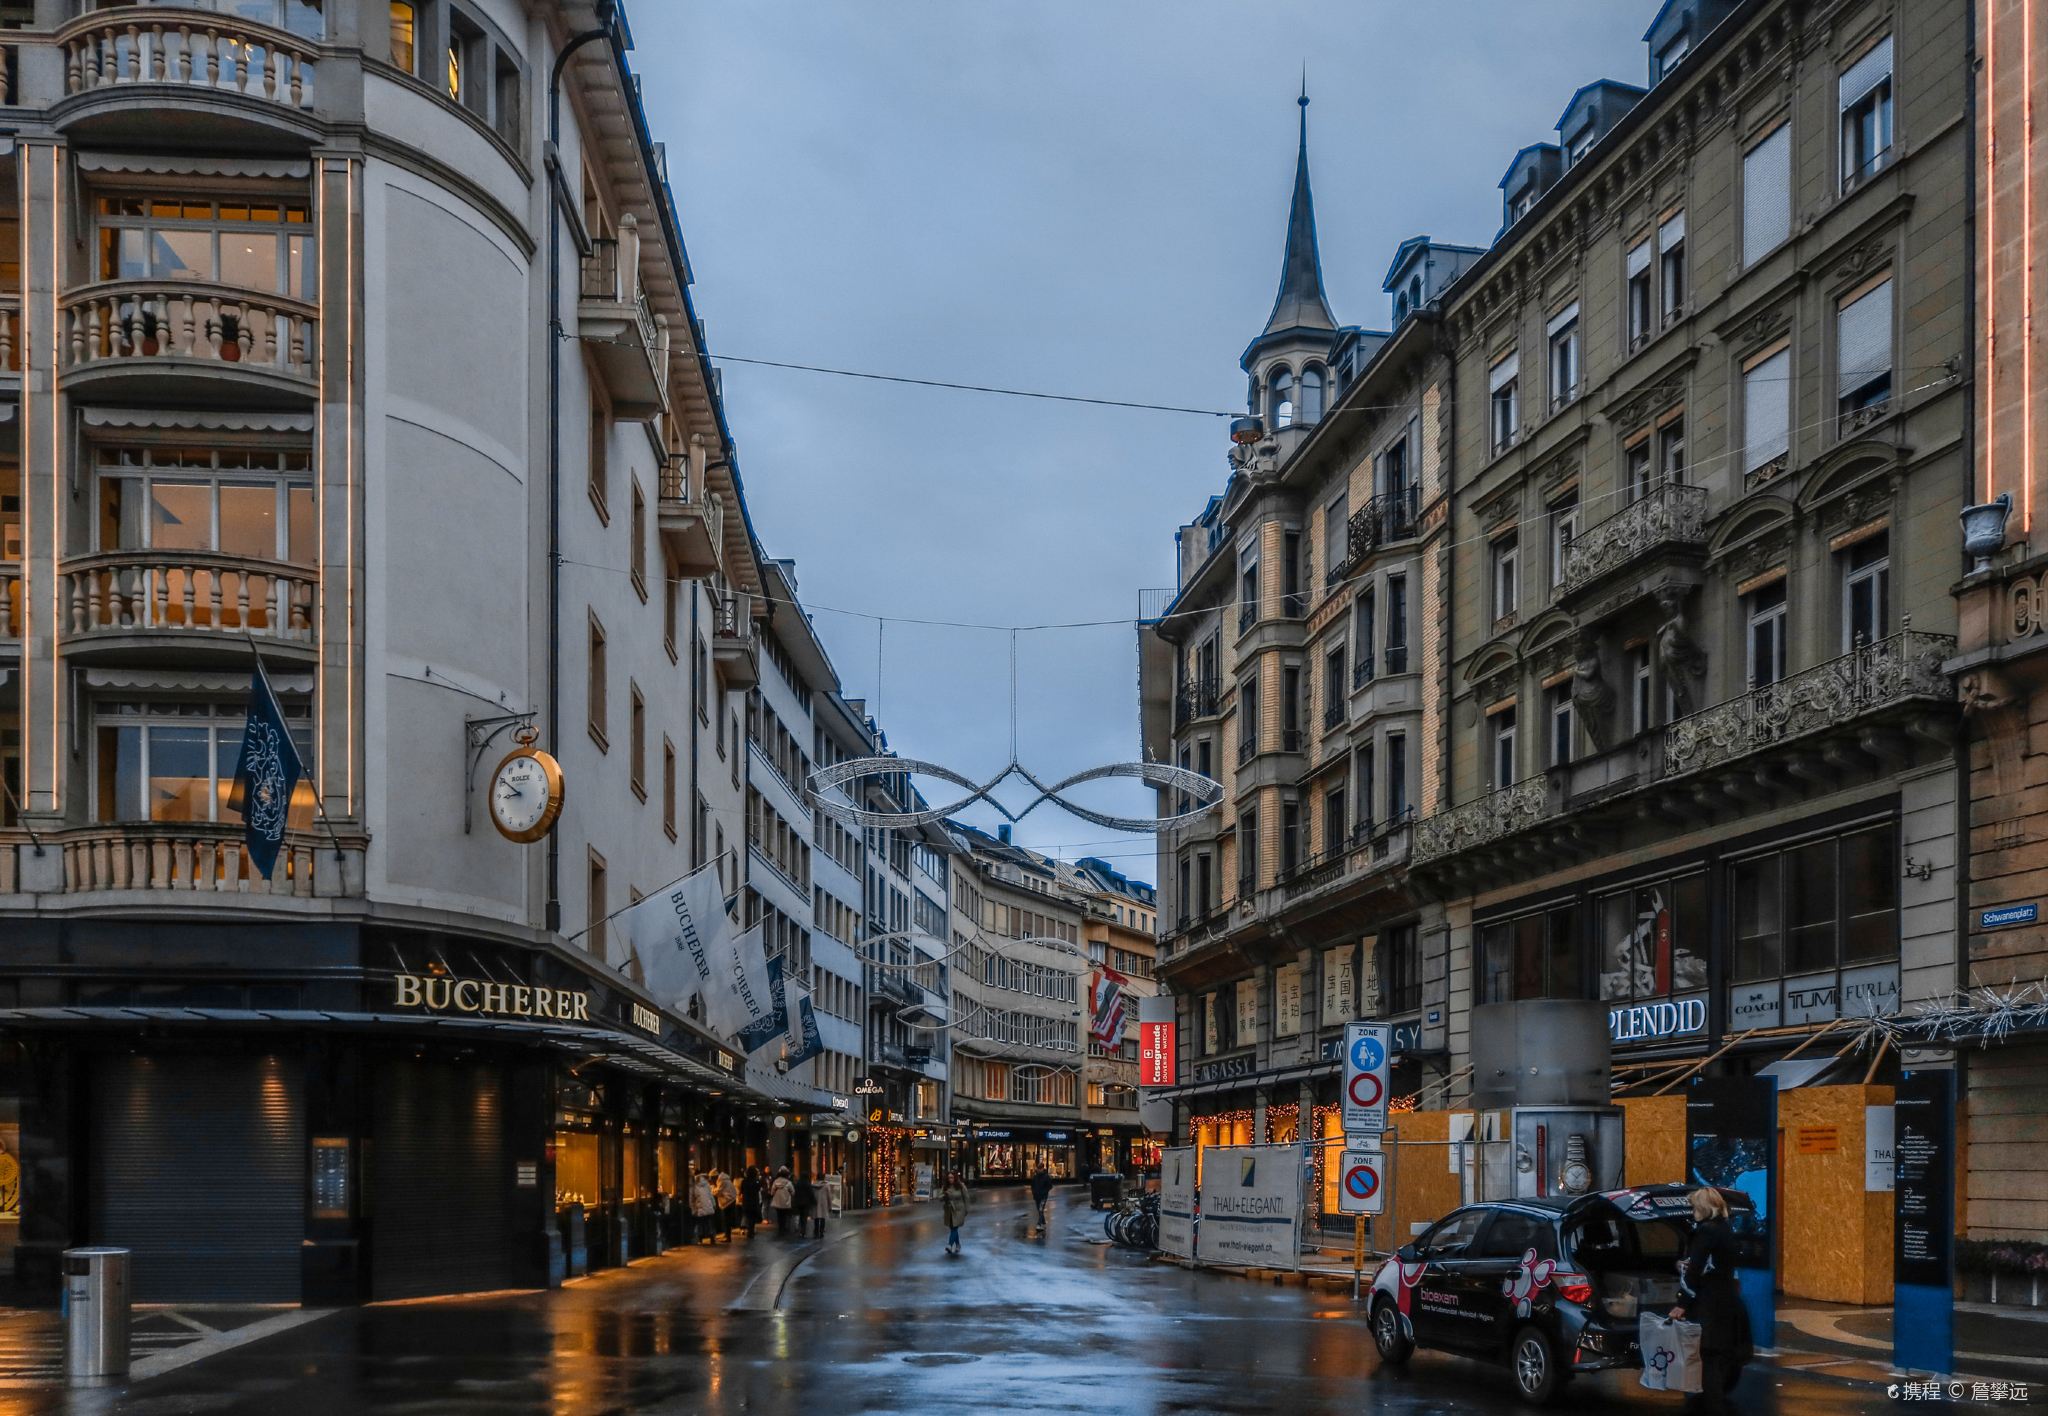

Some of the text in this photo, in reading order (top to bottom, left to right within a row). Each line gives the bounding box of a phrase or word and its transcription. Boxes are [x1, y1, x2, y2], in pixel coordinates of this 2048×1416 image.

[511, 774, 531, 782] ROLEX
[1983, 908, 2034, 924] Schwanenplatz
[671, 890, 711, 981] BUCHERER
[733, 947, 760, 1017] CHERER
[1340, 962, 1352, 1015] 万国表
[1846, 981, 1897, 1001] FURLA
[394, 974, 590, 1022] BUCHERER
[1735, 1001, 1780, 1015] COACH
[633, 1002, 660, 1036] BUCHERER
[1358, 1028, 1379, 1037] ZONE
[1153, 1024, 1162, 1083] Casagrande
[855, 1086, 884, 1094] OMEGA
[1354, 1157, 1373, 1165] ZONE
[1213, 1196, 1284, 1215] THALI+ELEGANTI
[1420, 1287, 1459, 1306] bioexam
